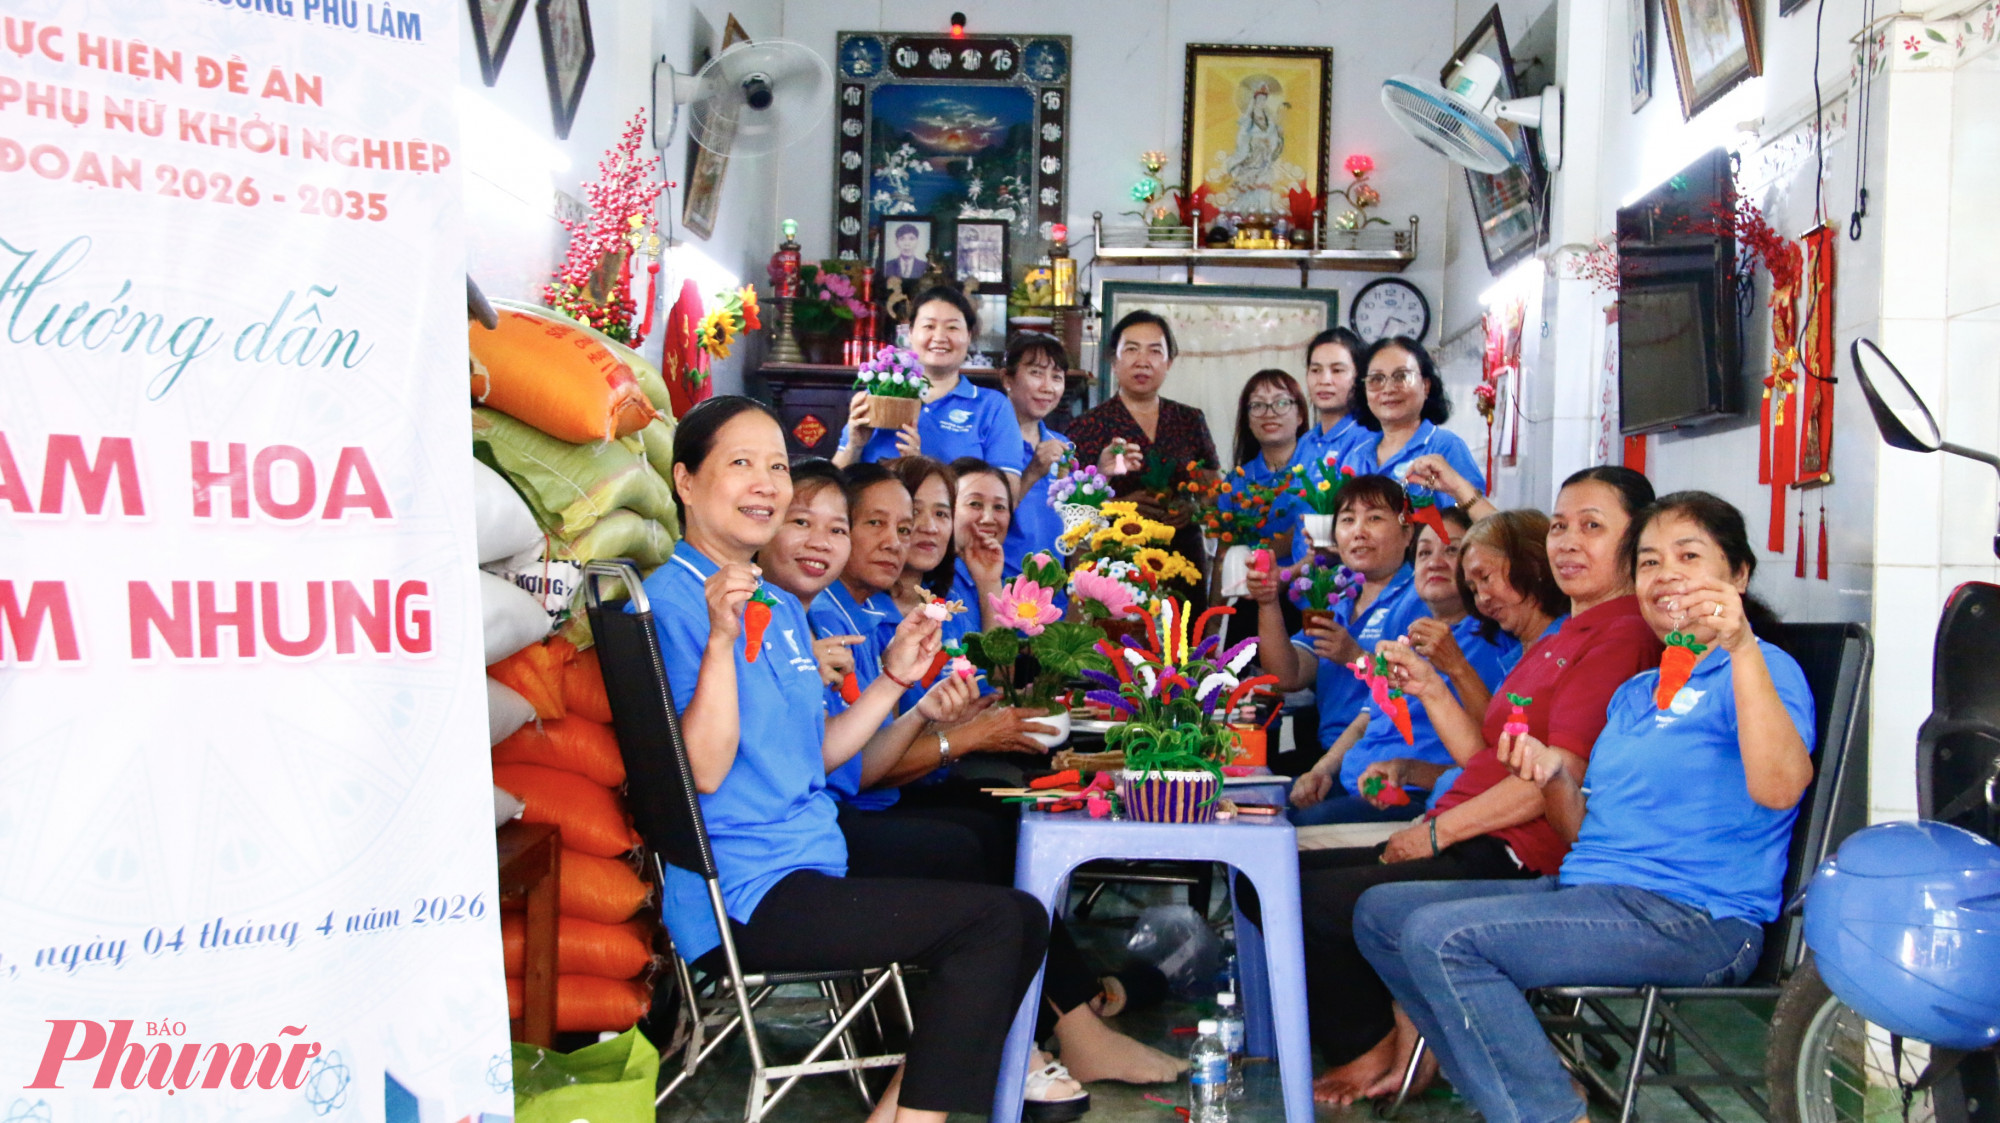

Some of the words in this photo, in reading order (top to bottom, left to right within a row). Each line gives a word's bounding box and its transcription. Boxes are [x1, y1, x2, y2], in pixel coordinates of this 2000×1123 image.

[4, 16, 64, 62] ỰC
[78, 31, 183, 84] HIỆN
[195, 54, 249, 95] ĐỀ
[261, 65, 323, 107] ÁN
[367, 2, 421, 41] LÂM
[104, 95, 167, 137] NỮ
[178, 108, 290, 156] KHỞI
[302, 127, 451, 175] NGHIỆP
[155, 164, 260, 207] 2026
[298, 184, 388, 221] 2035
[0, 235, 224, 401] Hướng
[234, 284, 375, 369] dẫn
[190, 440, 394, 520] HOA
[0, 579, 82, 662] M
[128, 579, 432, 659] NHUNG
[35, 934, 128, 973] ngày
[143, 925, 186, 955] 04
[200, 916, 301, 948] tháng
[315, 909, 335, 936] 4
[346, 907, 401, 933] năm
[412, 891, 486, 924] 2026
